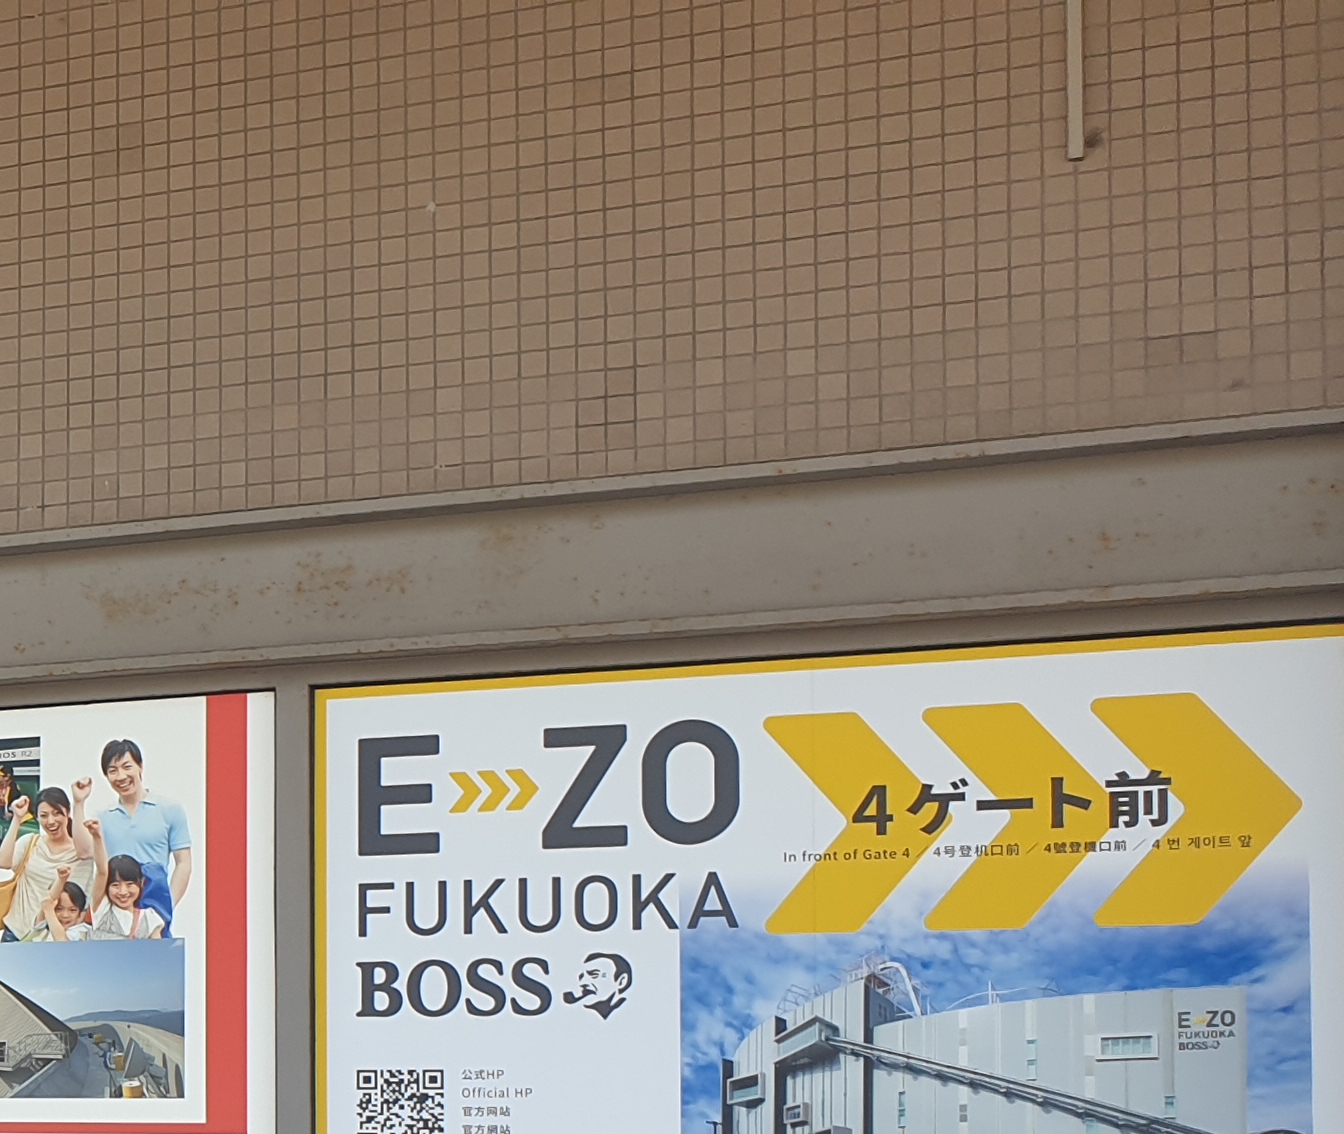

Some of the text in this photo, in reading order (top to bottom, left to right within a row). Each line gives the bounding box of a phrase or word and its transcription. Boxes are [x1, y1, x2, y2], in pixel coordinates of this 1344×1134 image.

[851, 771, 1173, 836] 4ゲート前
[784, 848, 911, 863] In front of Gate 4
[359, 872, 739, 937] FUKUOKA
[356, 957, 552, 1017] BOSS
[1178, 1030, 1235, 1039] FUKUOKA
[1179, 1041, 1210, 1050] BOSS
[462, 1070, 504, 1080] 公式HP
[462, 1087, 532, 1098] Official HP
